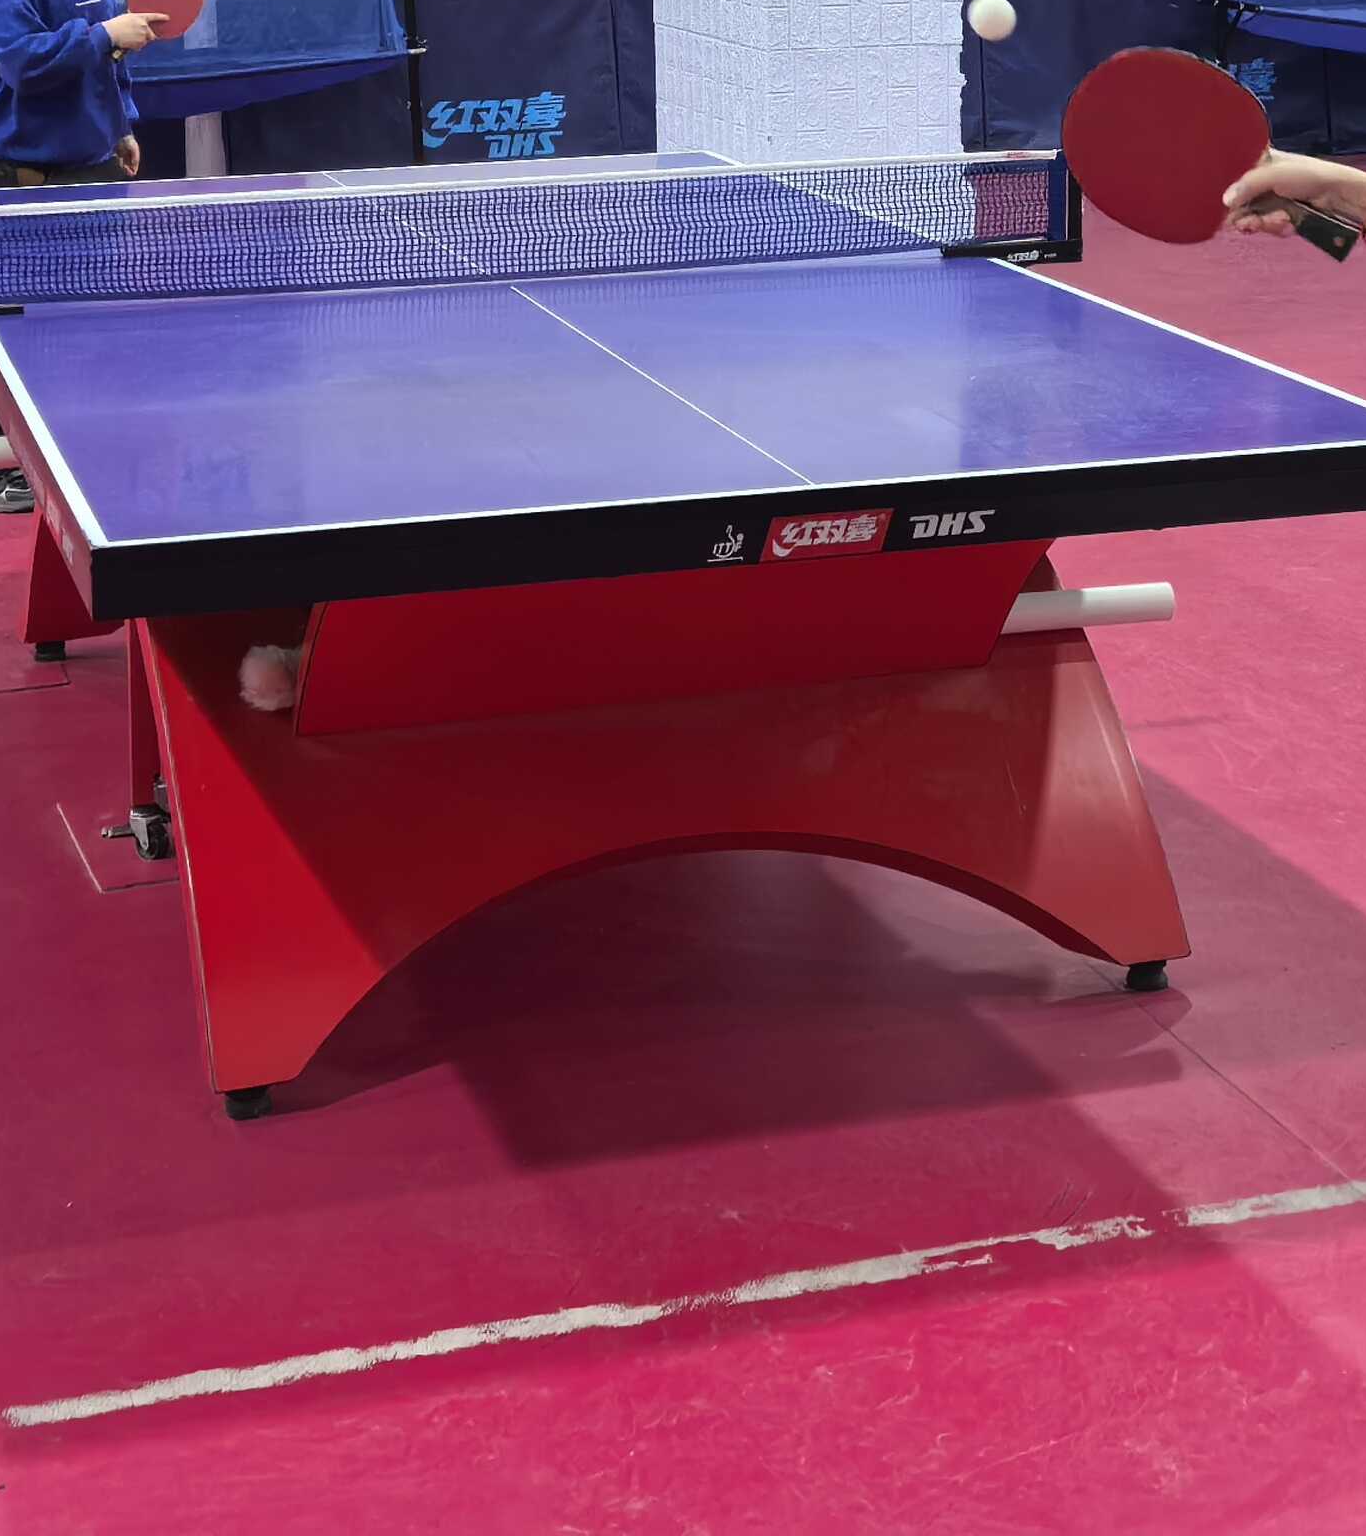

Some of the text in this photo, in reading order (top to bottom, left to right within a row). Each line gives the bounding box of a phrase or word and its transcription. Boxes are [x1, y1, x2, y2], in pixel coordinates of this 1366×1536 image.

[425, 92, 567, 138] 红双喜
[485, 129, 562, 159] DHS
[774, 514, 879, 552] 红双喜
[909, 509, 996, 540] DHS
